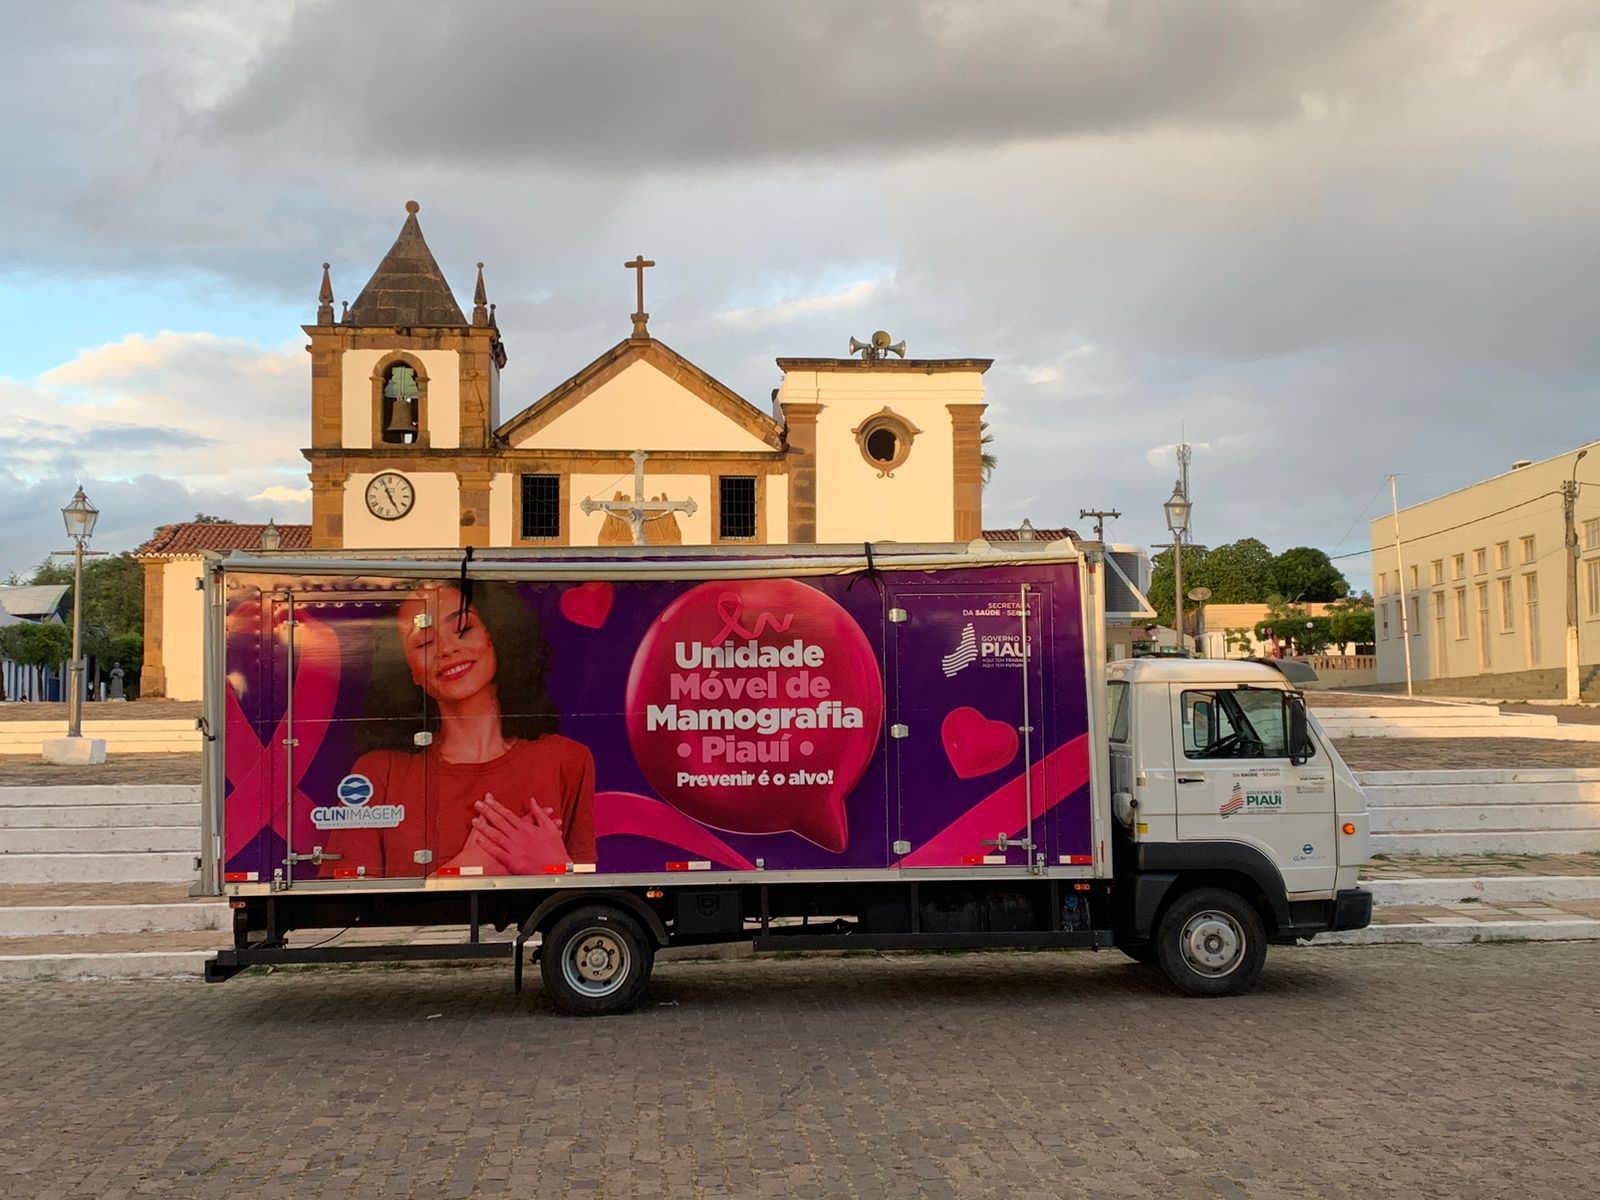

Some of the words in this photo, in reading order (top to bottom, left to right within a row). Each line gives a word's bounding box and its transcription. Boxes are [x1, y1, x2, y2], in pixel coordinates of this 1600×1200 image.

[975, 608, 1001, 616] SAÚDE
[675, 639, 825, 670] Unidade
[670, 670, 777, 701] Móvel
[785, 670, 831, 699] de
[646, 700, 864, 735] Mamografia
[702, 733, 792, 764] Piauí
[676, 771, 755, 788] Prevenir
[758, 769, 770, 787] é
[773, 772, 786, 787] o
[789, 769, 834, 786] alvo!
[313, 807, 403, 822] CLINIMAGEM
